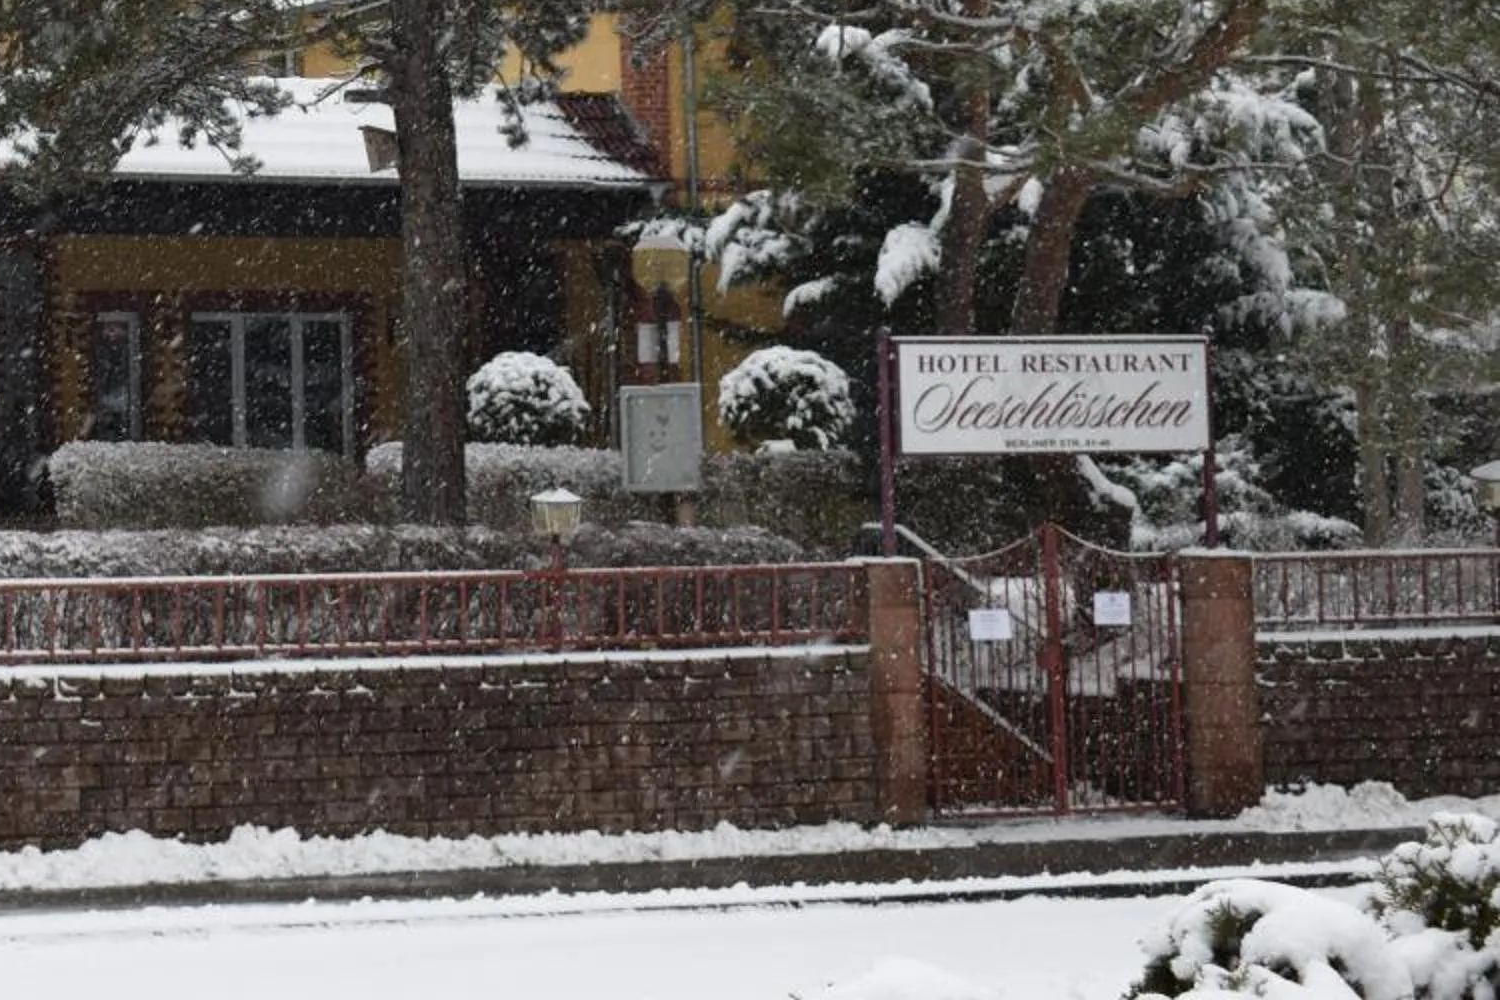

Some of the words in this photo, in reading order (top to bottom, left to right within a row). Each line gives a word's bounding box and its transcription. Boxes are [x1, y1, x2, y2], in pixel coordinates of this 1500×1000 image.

[918, 353, 1008, 373] HOTEL
[1021, 352, 1193, 373] RESTAURANT
[913, 376, 1192, 433] Seeschlösschen
